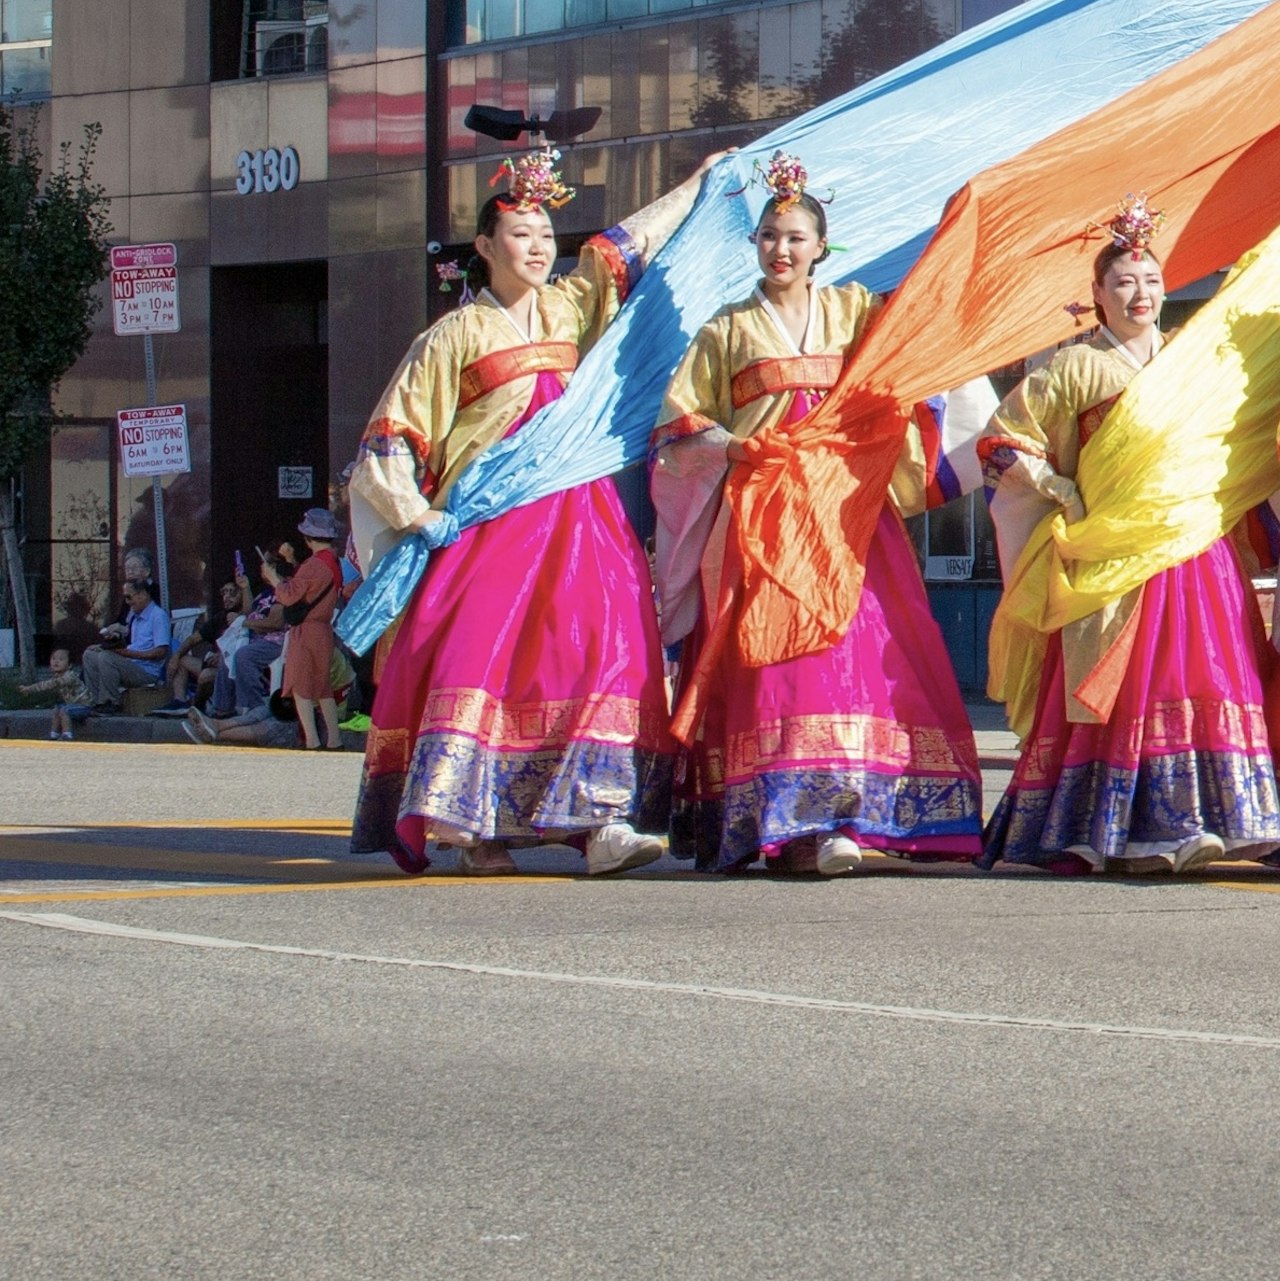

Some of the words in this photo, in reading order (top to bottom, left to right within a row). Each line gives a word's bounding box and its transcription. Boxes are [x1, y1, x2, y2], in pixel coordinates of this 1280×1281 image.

[236, 146, 300, 195] 3130
[115, 248, 172, 258] ANTI-GRIDLOCK
[133, 255, 154, 264] ZONE
[115, 268, 174, 280] TOW-AWAY
[115, 280, 132, 298] NO
[136, 280, 175, 294] STOPPING
[127, 408, 177, 419] TOW-AWAY
[129, 418, 175, 426] TEMPORARY
[124, 428, 143, 444] NO
[145, 427, 183, 442] STOPPING
[129, 460, 163, 469] SATURDAY
